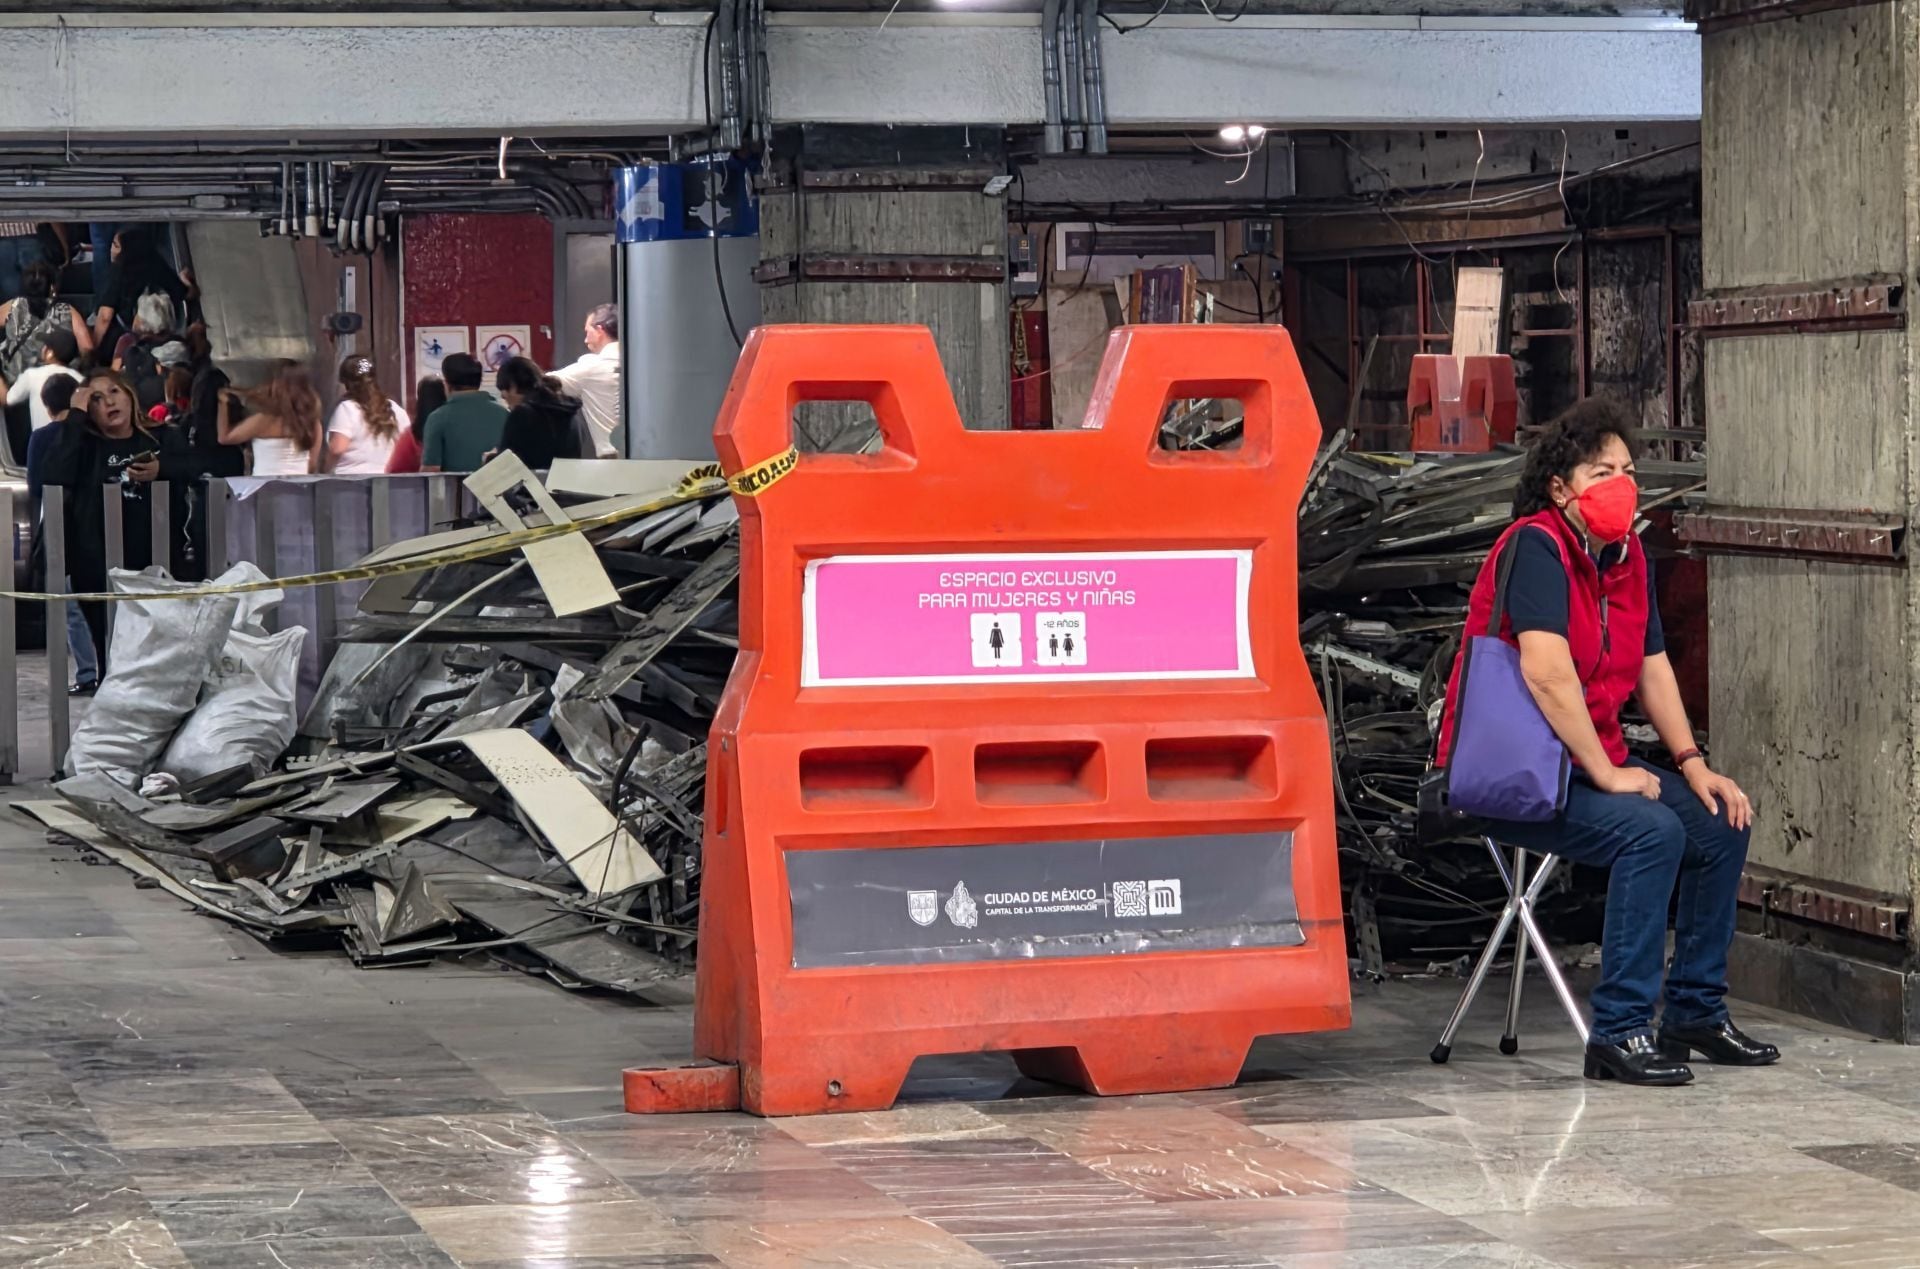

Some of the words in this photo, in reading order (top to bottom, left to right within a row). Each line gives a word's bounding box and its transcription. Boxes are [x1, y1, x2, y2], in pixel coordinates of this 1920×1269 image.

[939, 571, 1016, 587] ESPACIO
[1021, 570, 1116, 586] EXCLUSIVO
[918, 592, 967, 609] PARA
[971, 591, 1061, 608] MUJERES
[1066, 591, 1078, 607] Y
[1083, 588, 1136, 606] NIÑAS
[1056, 619, 1080, 628] AÑOS
[984, 891, 1030, 905] CIUDAD
[1032, 891, 1049, 903] DE
[1051, 888, 1097, 903] MÉXICO
[985, 907, 1012, 916] CAPITAL
[1013, 906, 1024, 915] DE
[1025, 906, 1034, 914] LA
[1034, 902, 1098, 913] TRANSFORMACIÓN
